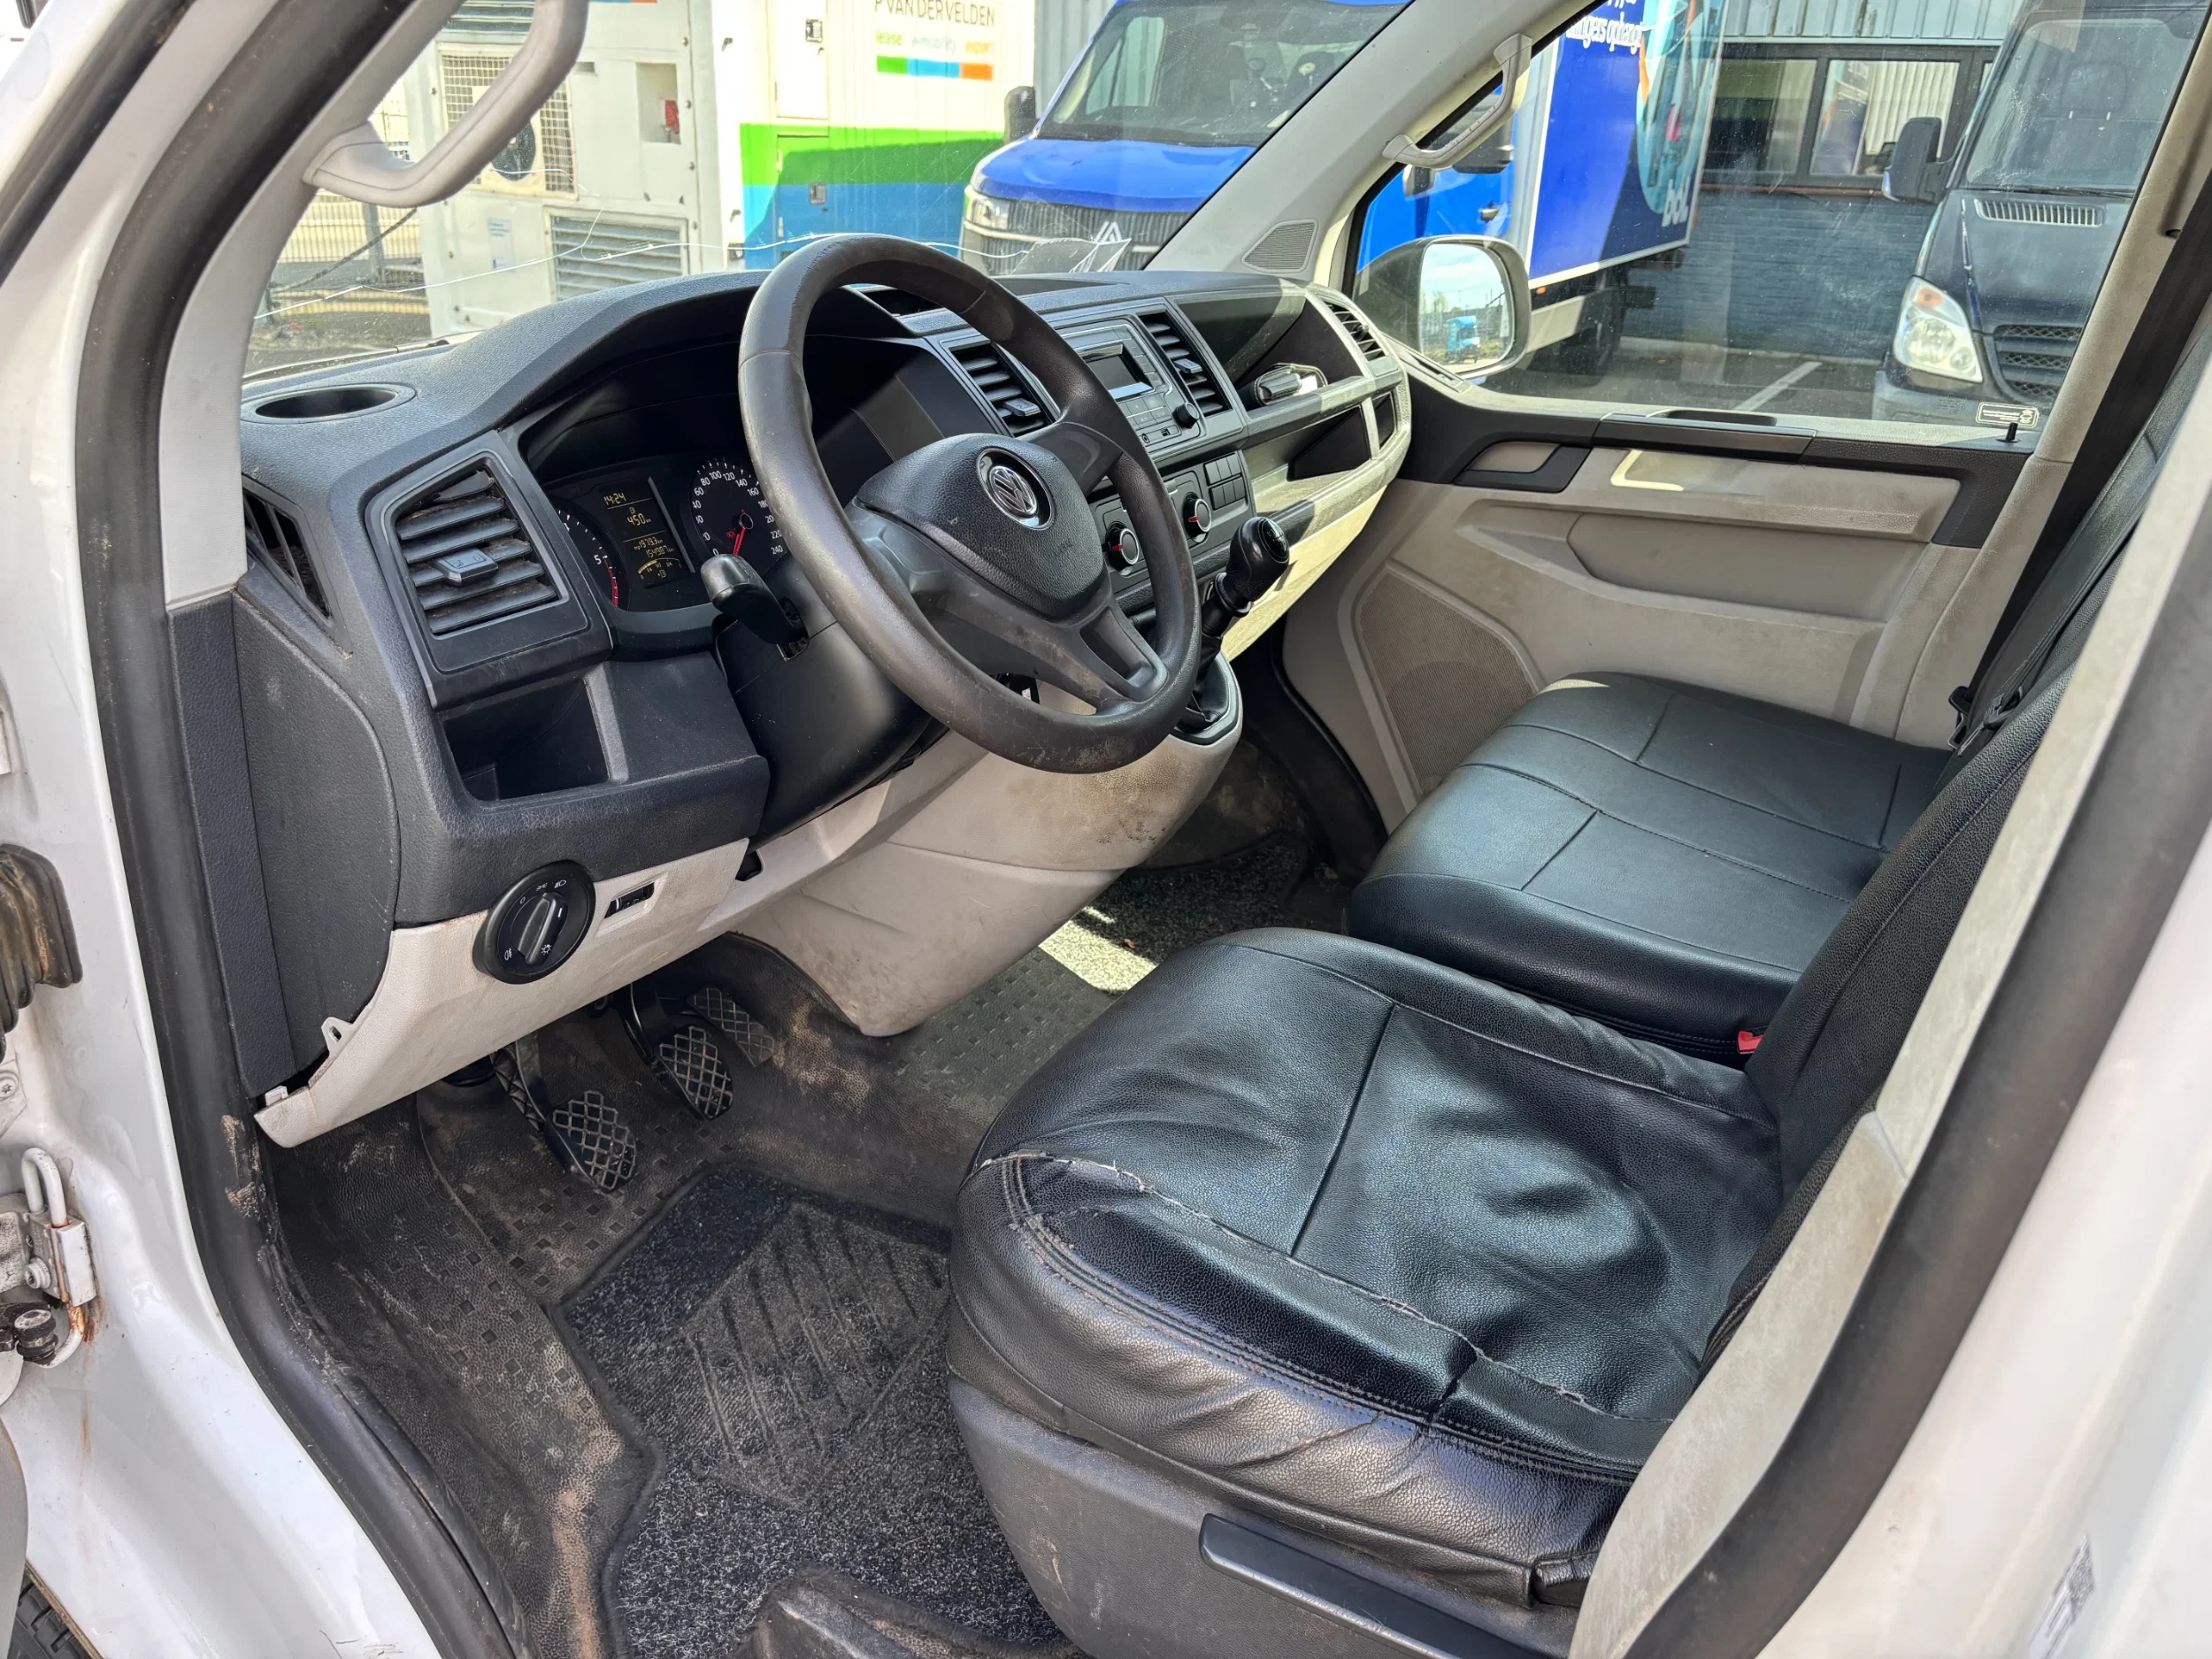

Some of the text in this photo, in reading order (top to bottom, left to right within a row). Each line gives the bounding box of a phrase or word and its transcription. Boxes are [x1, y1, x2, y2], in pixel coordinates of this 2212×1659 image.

[945, 1, 995, 27] VELDEN
[709, 470, 722, 480] 100
[723, 472, 735, 481] 120
[700, 477, 710, 487] 80
[735, 478, 748, 488] 140
[694, 487, 704, 496] 60
[747, 487, 759, 496] 160
[603, 492, 626, 505] 14:24
[771, 545, 784, 556] 240
[594, 554, 602, 565] 5
